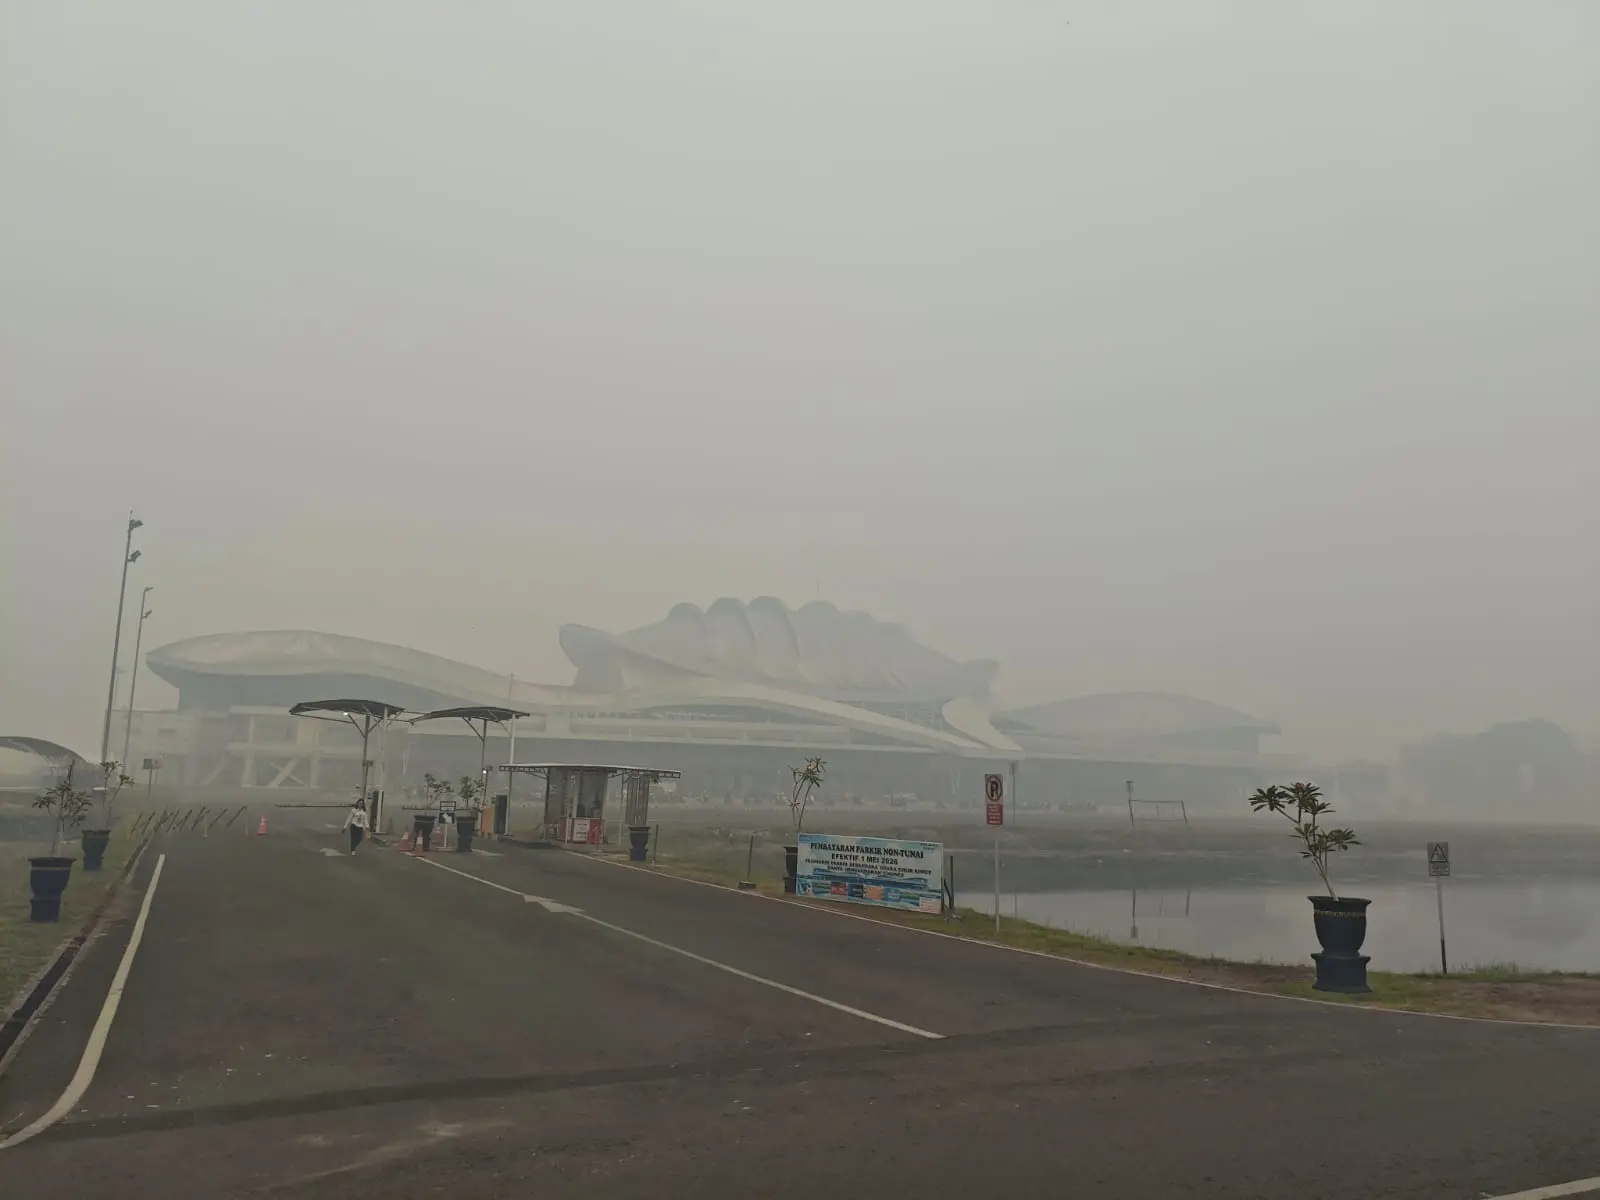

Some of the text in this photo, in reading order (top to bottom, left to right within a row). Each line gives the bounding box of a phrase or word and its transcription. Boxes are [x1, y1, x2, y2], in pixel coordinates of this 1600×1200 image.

[810, 843, 924, 859] PEMBAYARAN PARKIR NON-TUNAI
[831, 853, 859, 862] EFEKTIF
[880, 857, 898, 865] 2026
